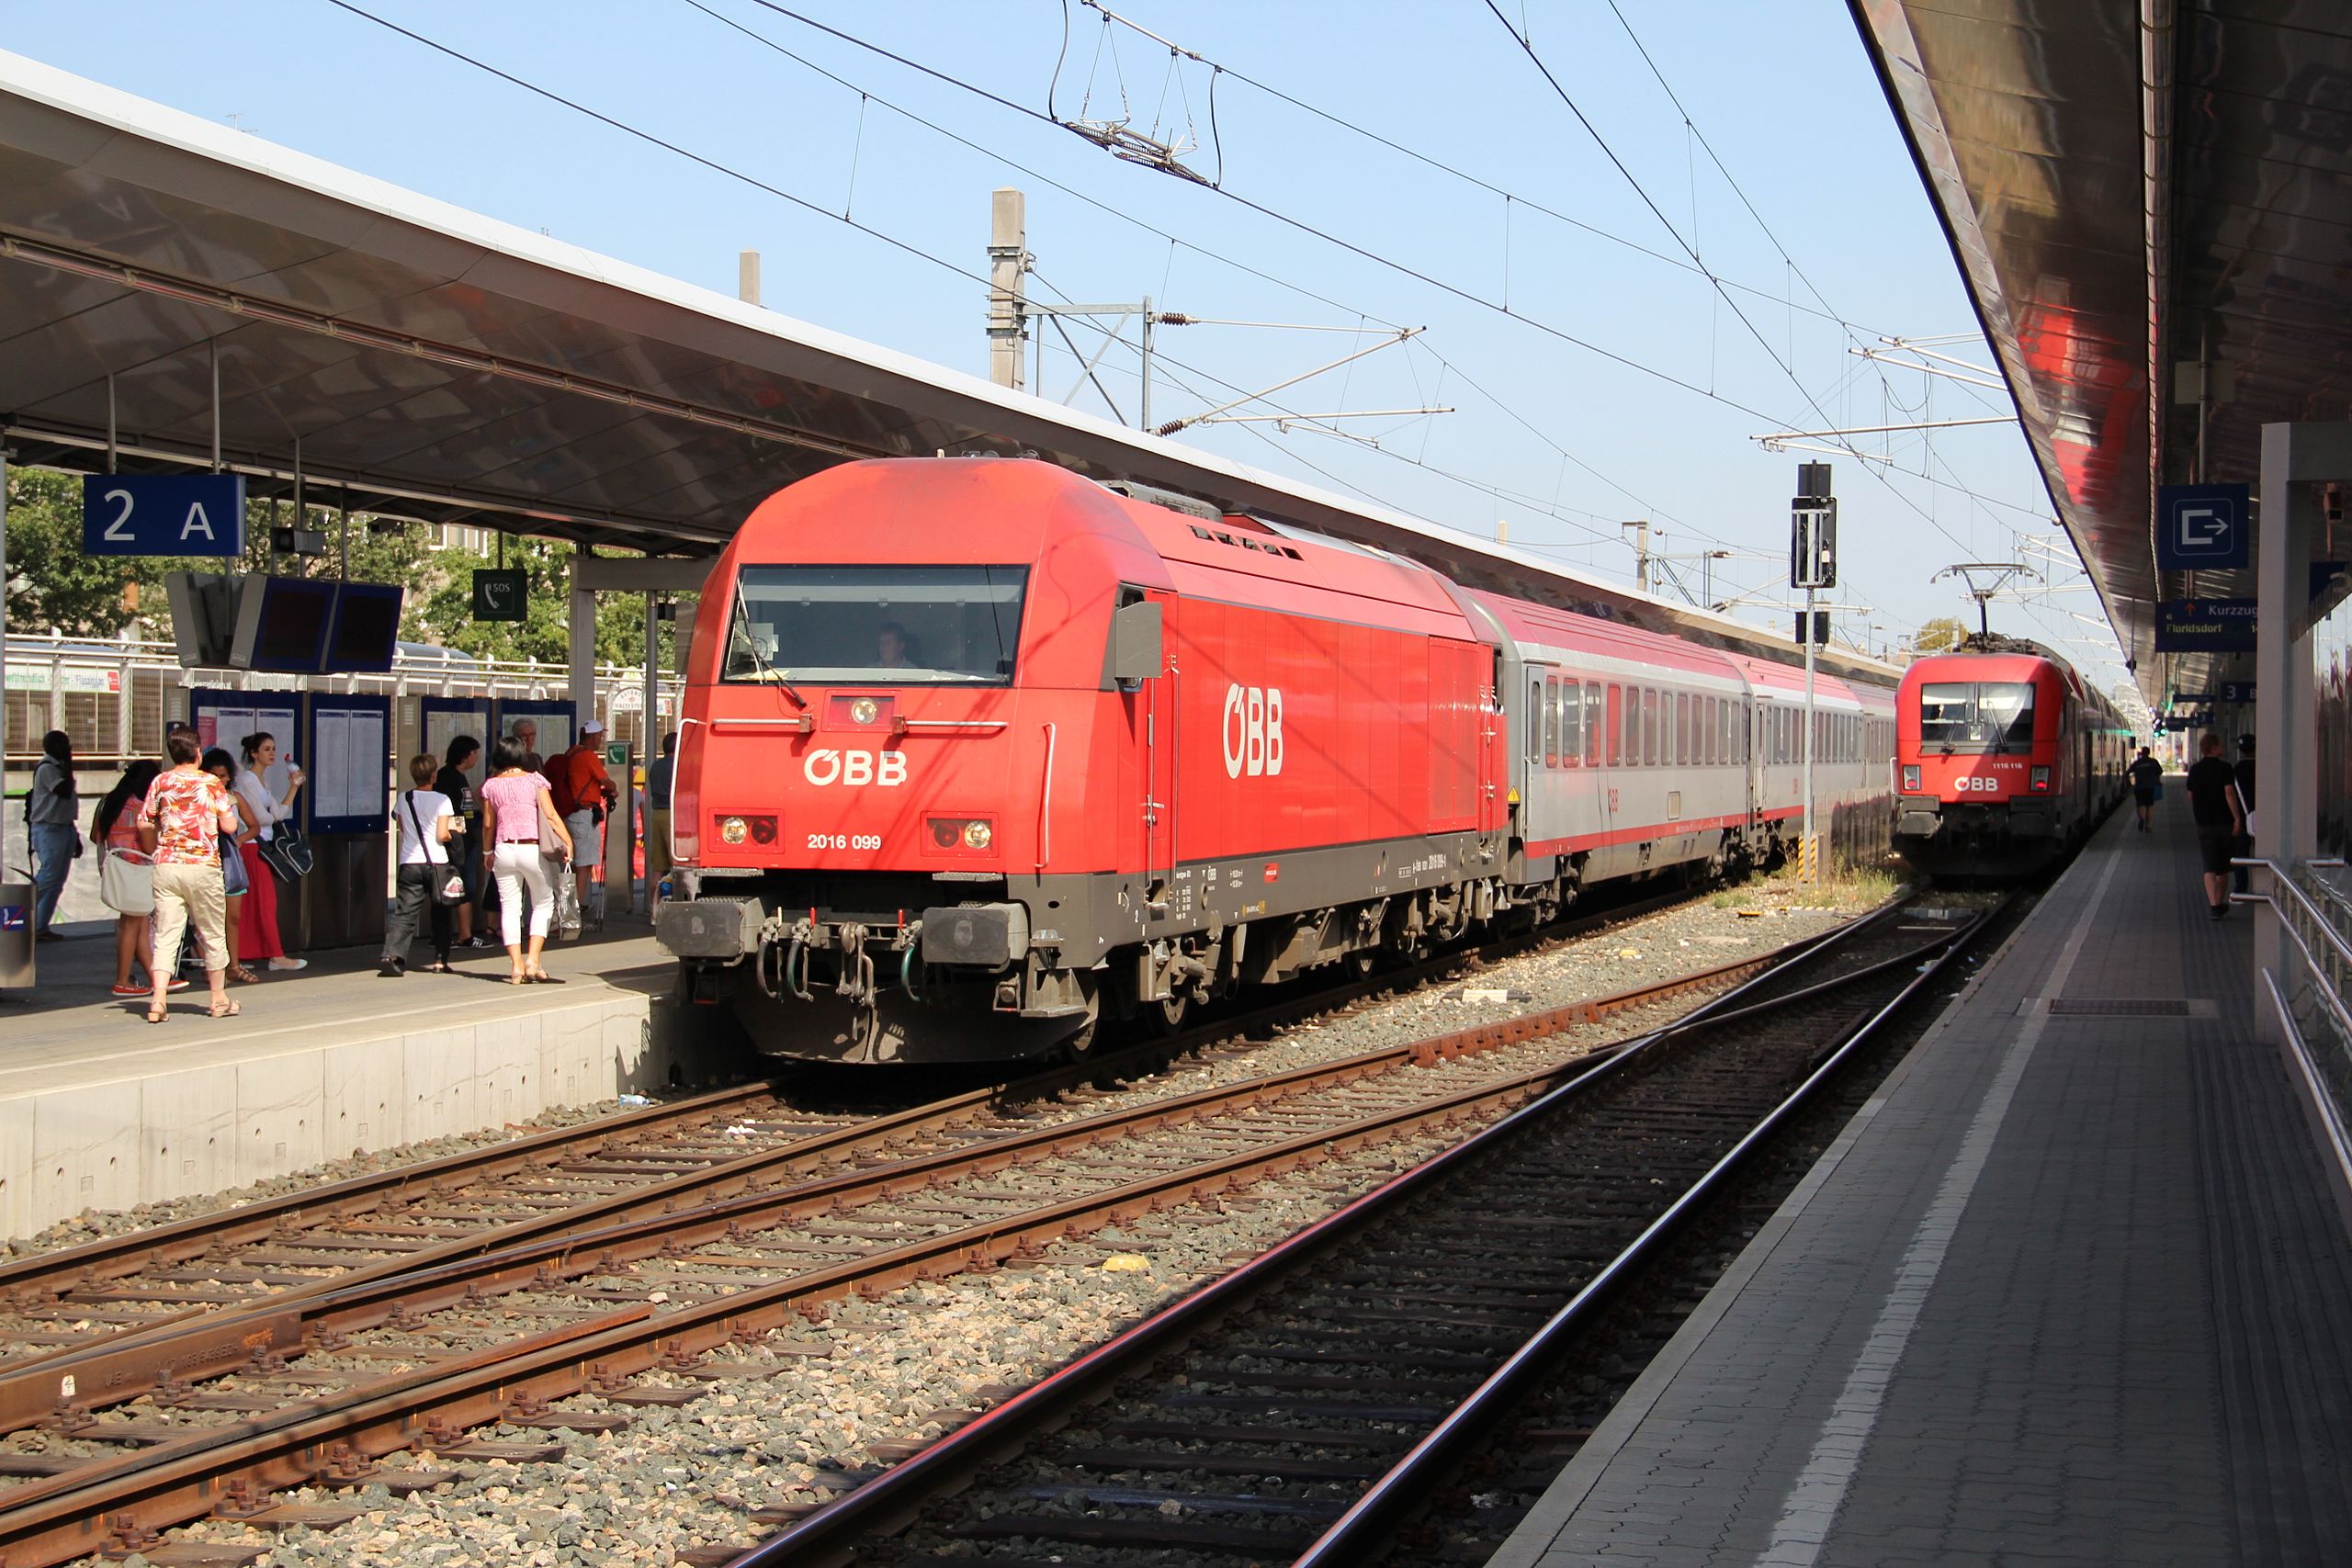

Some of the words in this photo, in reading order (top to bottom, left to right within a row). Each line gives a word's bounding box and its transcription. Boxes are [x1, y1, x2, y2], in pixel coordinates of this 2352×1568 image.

[104, 489, 135, 541] 2
[179, 502, 215, 540] A
[492, 583, 511, 592] SOS
[2209, 604, 2257, 617] Kurzzug
[2226, 685, 2236, 699] 3
[1223, 683, 1283, 779] ÖBB
[804, 749, 908, 786] ÖBB
[1954, 776, 1998, 791] ÖBB
[808, 834, 846, 849] 2016
[852, 835, 882, 850] 099
